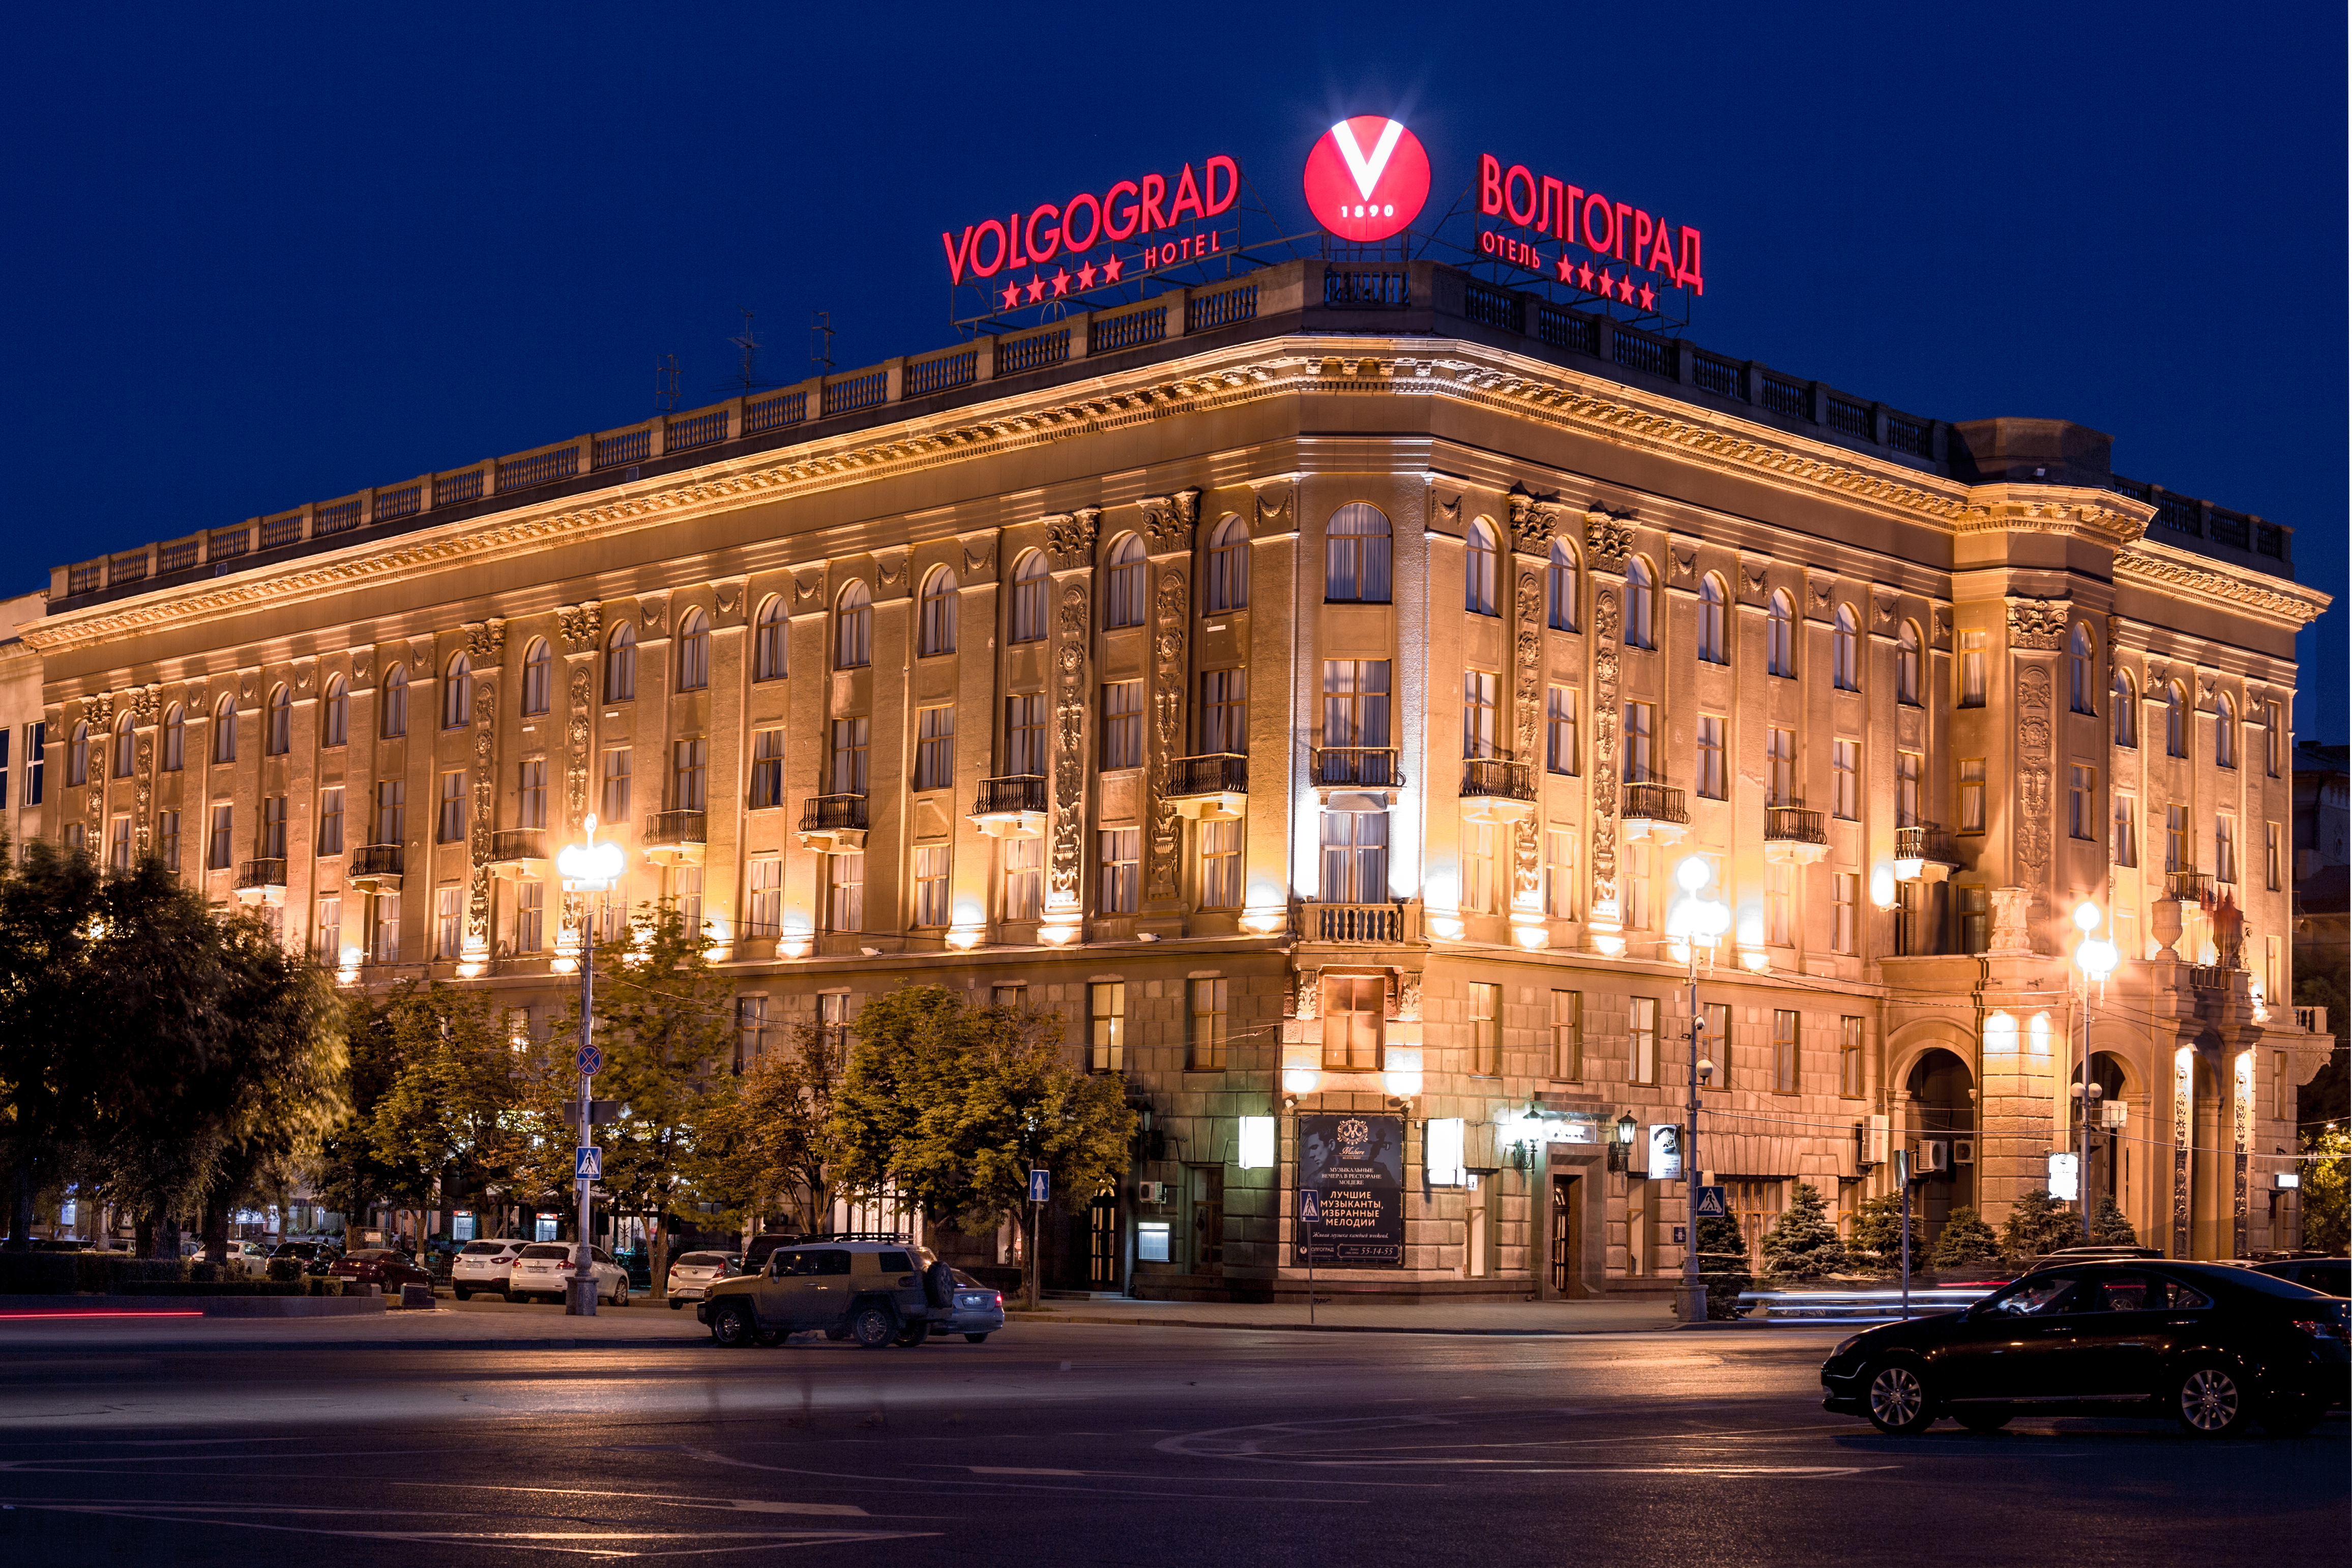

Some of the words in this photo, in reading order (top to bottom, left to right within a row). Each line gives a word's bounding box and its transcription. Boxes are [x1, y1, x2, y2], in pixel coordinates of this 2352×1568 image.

[943, 155, 1240, 286] VOLGOGRAD
[1341, 204, 1393, 218] 1890
[1480, 153, 1703, 296] ВОЛГОГРАД
[1144, 231, 1220, 270] HOTEL
[1480, 231, 1540, 269] ОТЕЛЬ
[1320, 1200, 1384, 1209] МУЗЫКАНТЫ,
[1326, 1219, 1375, 1228] МЕЛОДИИ
[1361, 1247, 1393, 1255] 55-14-55
